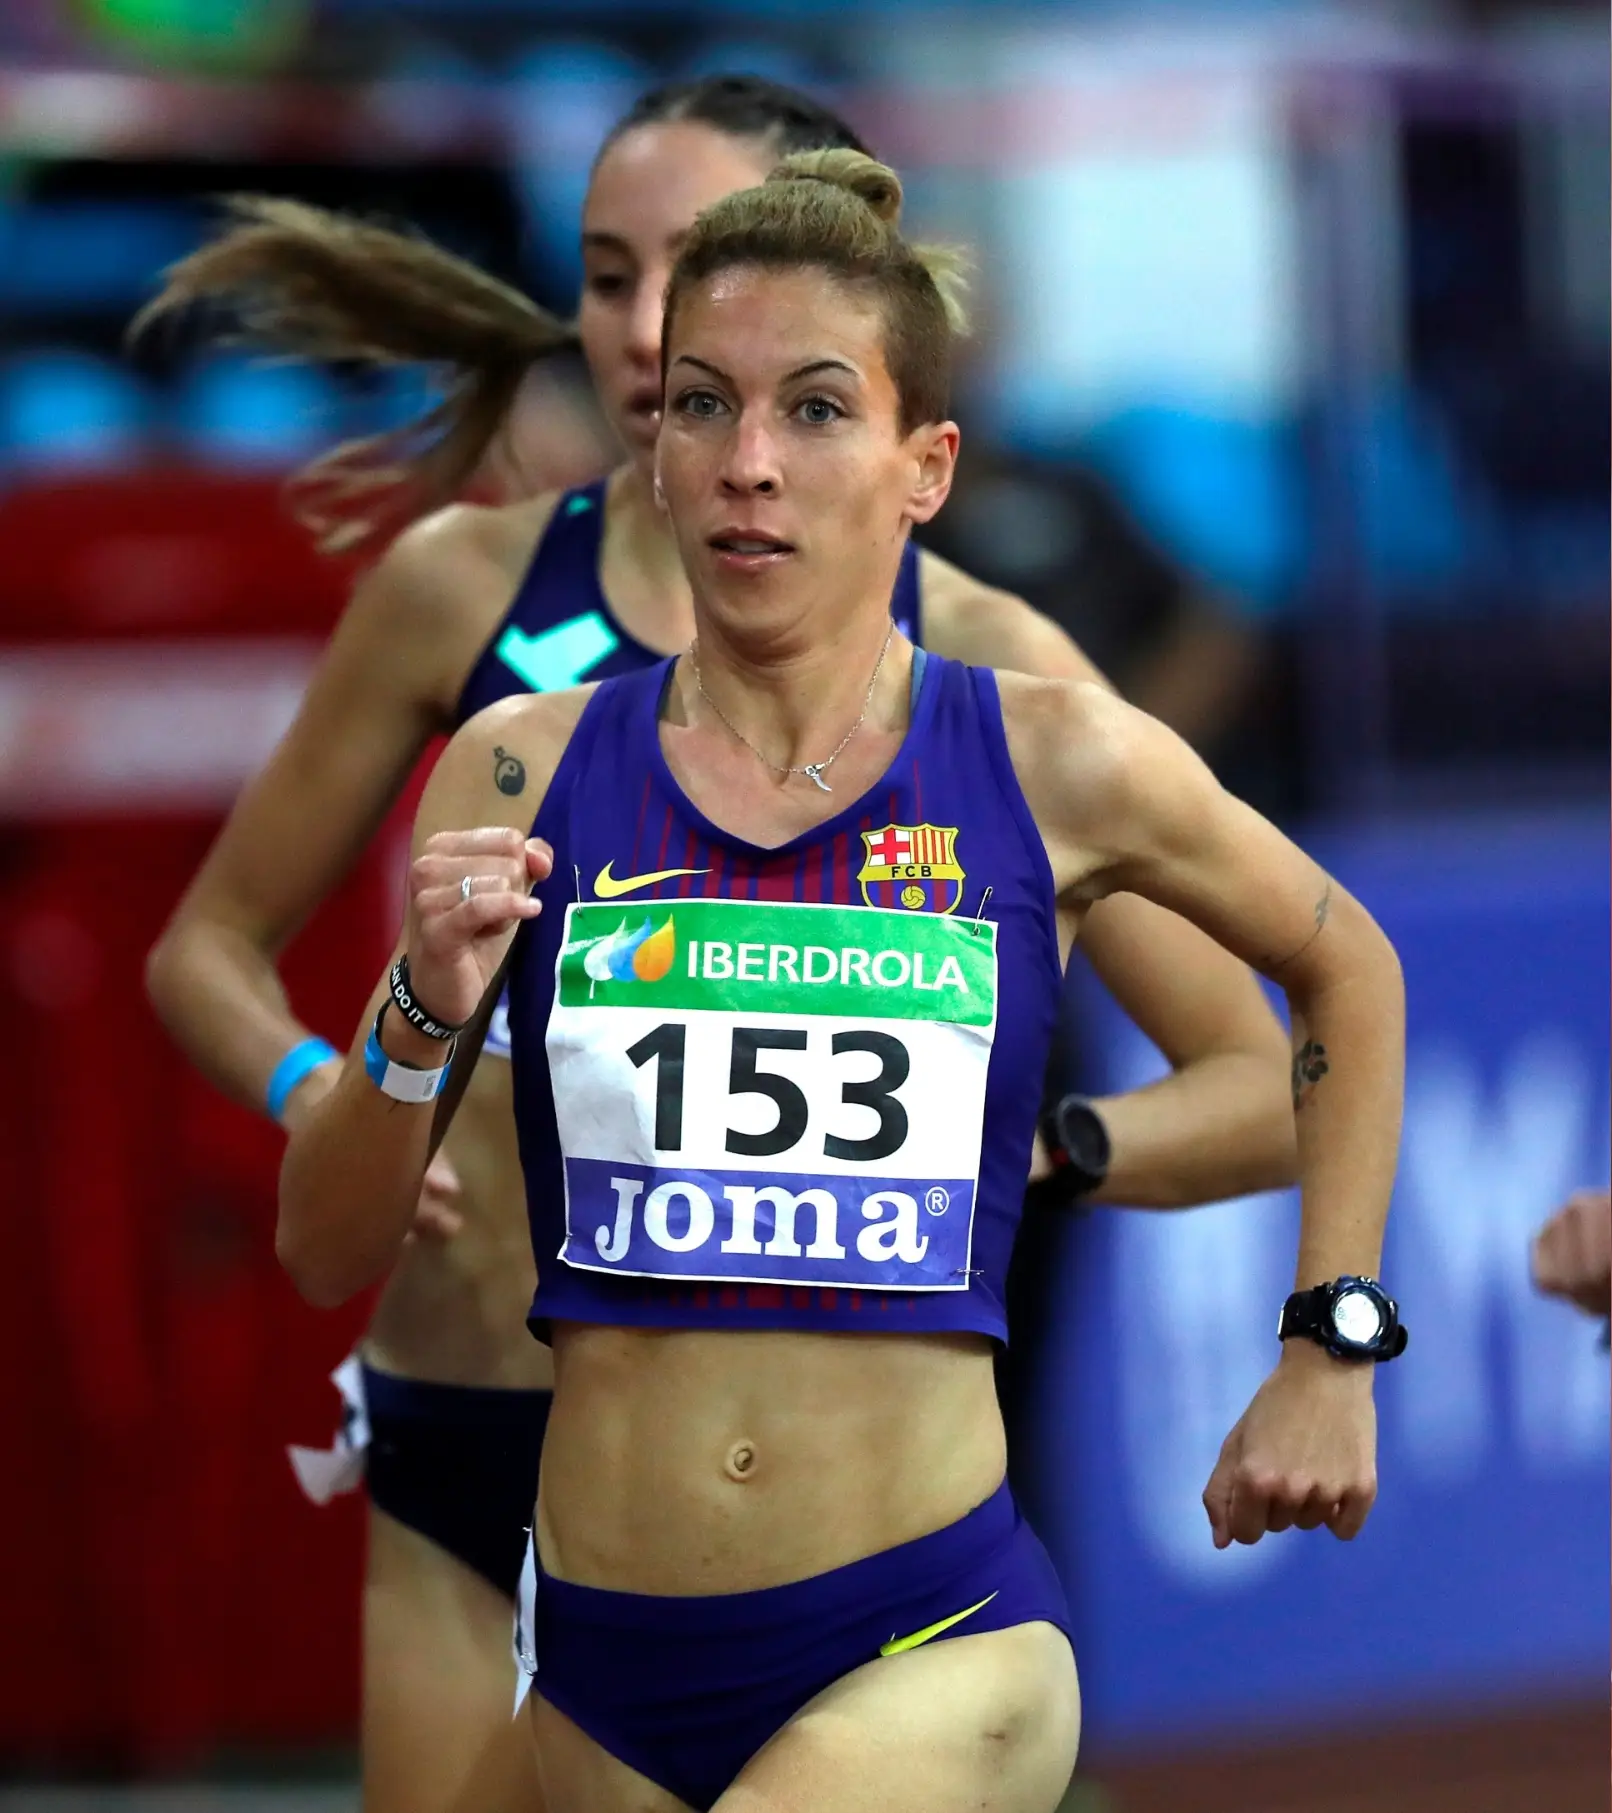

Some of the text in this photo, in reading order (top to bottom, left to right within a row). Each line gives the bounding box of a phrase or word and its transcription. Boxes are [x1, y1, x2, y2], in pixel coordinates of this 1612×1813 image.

[688, 940, 969, 993] IBERDROLA
[394, 983, 411, 1009] DO
[408, 1006, 426, 1023] IT
[625, 1022, 911, 1162] 153
